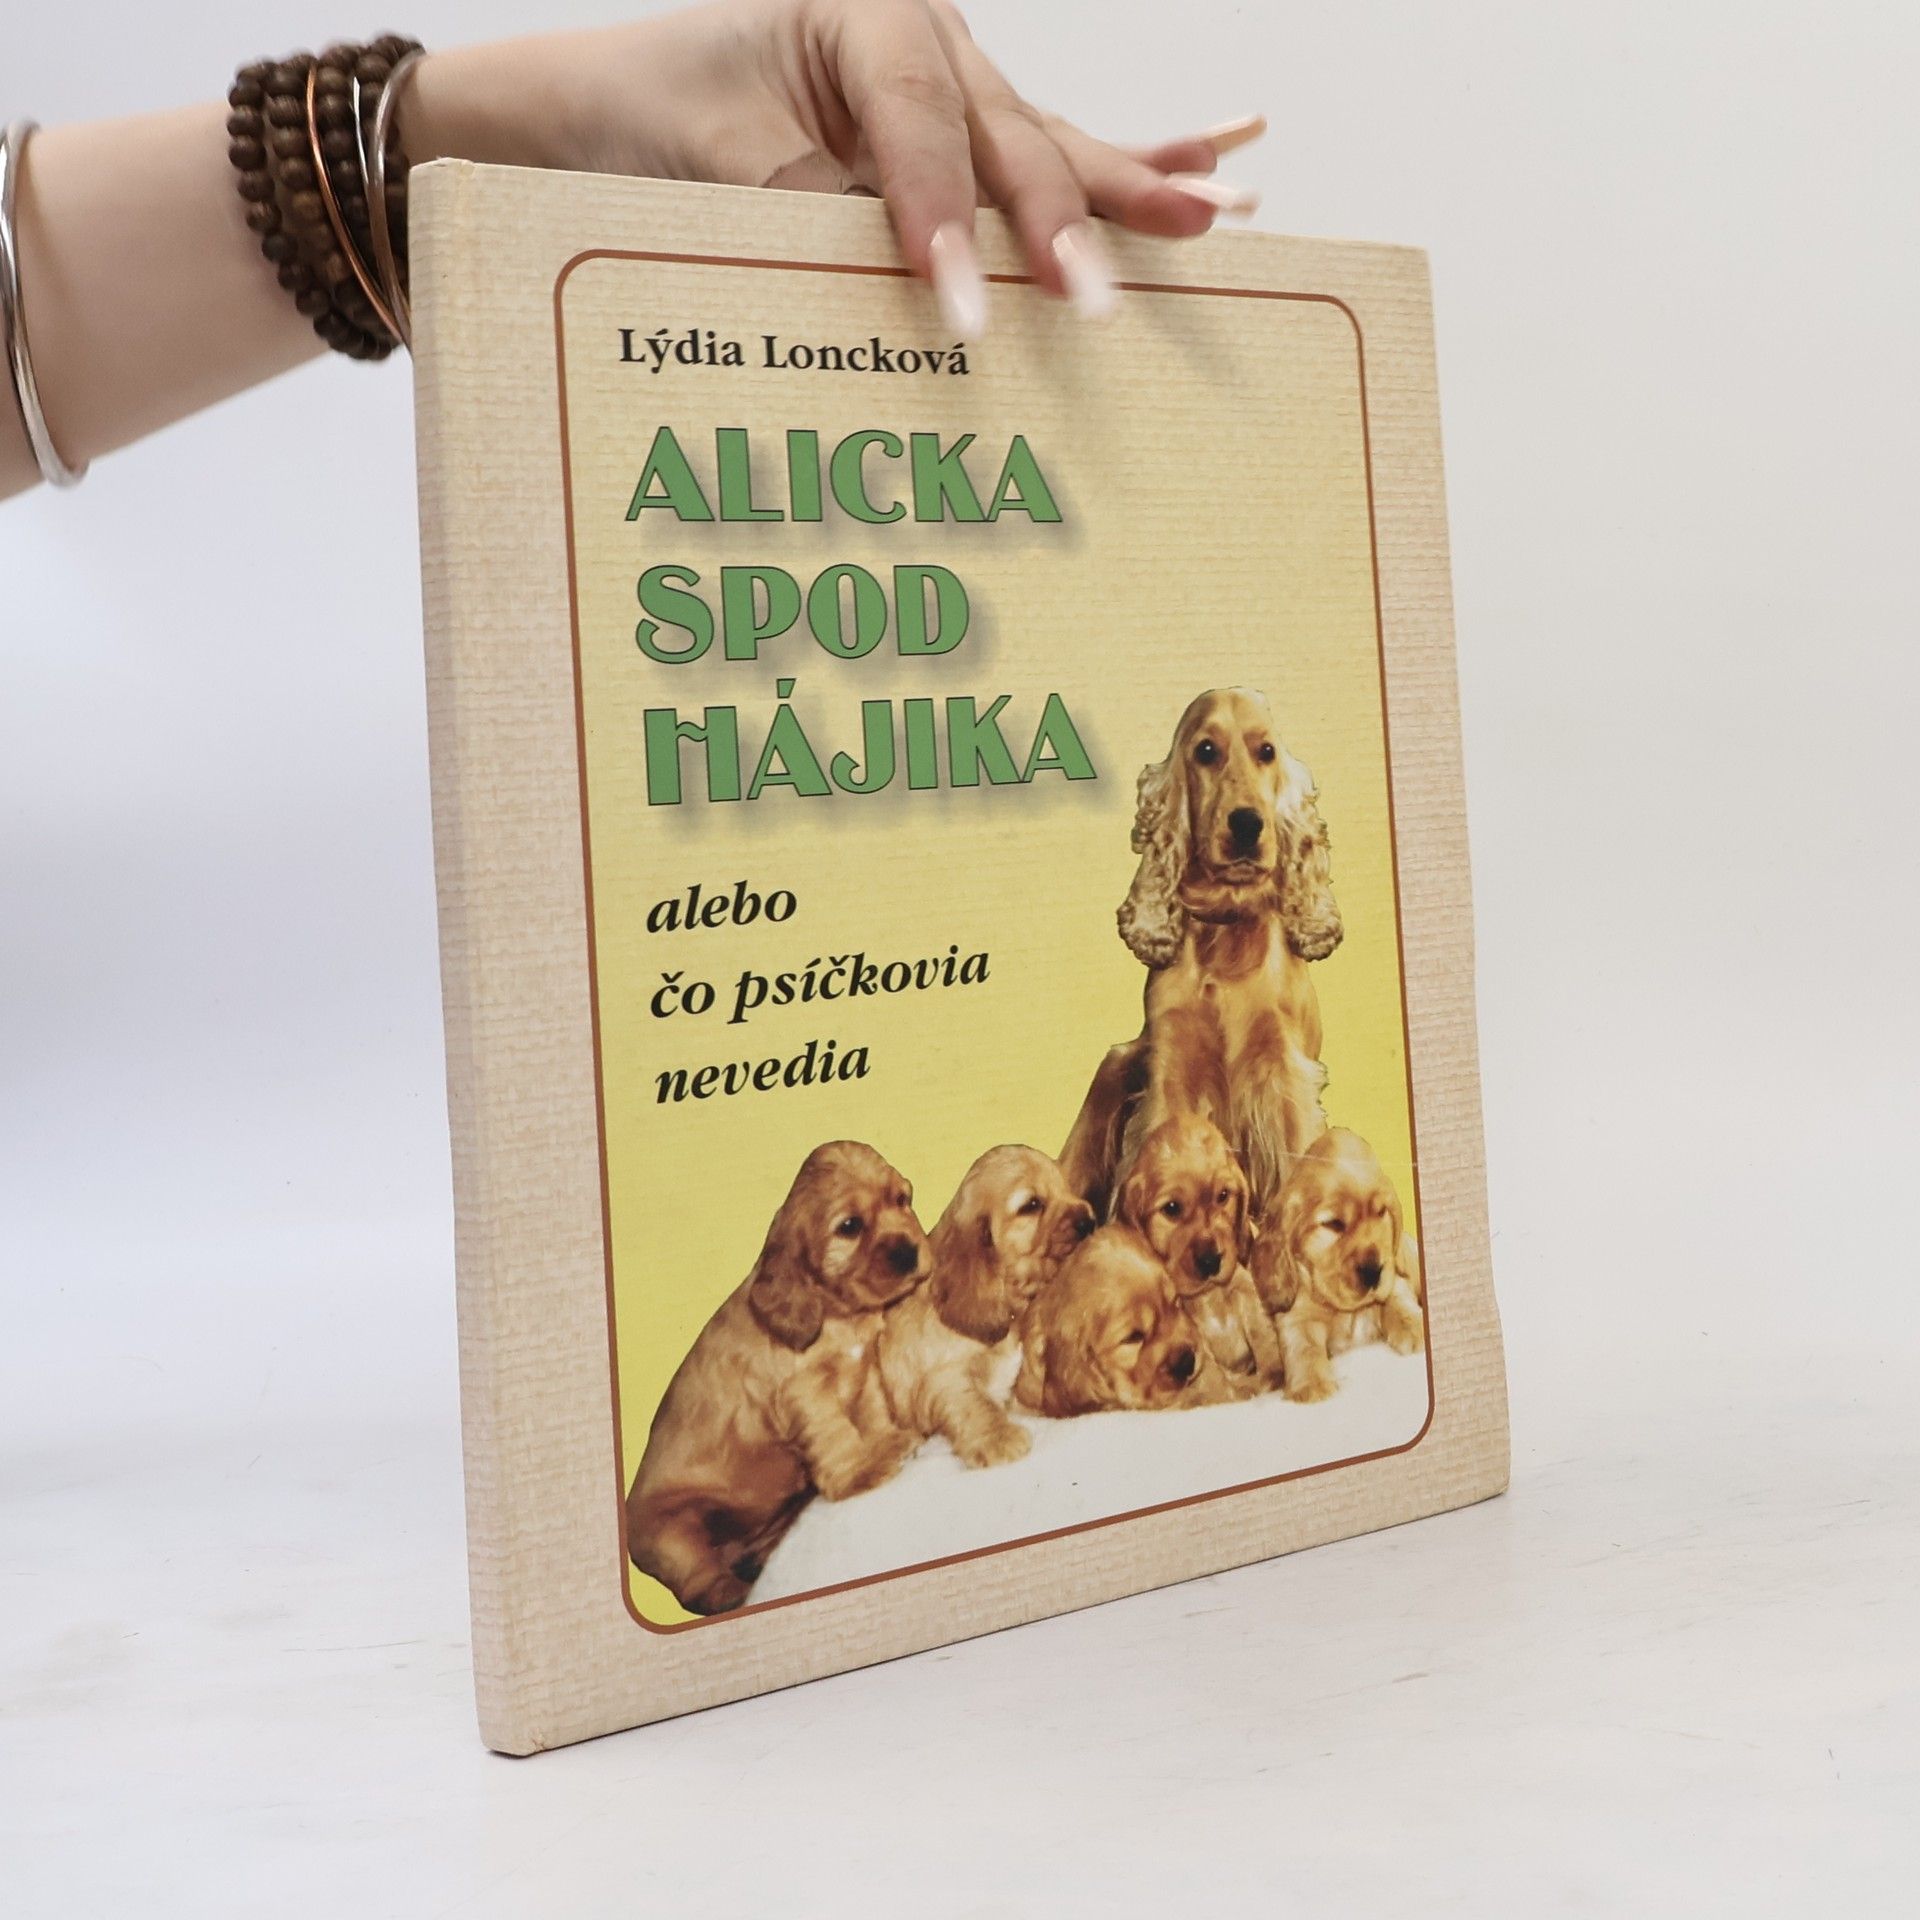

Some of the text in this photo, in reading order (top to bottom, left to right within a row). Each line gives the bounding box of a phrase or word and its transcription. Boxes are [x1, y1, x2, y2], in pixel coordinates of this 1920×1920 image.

[619, 328, 970, 376] Lýdia Loncková
[625, 426, 1064, 523] ALICKA
[636, 563, 972, 665] SPOD
[643, 678, 1098, 806] HÁJIKA
[646, 880, 797, 934] alebo
[651, 944, 989, 1025] čo psíčkovia
[655, 1039, 870, 1104] nevedia
